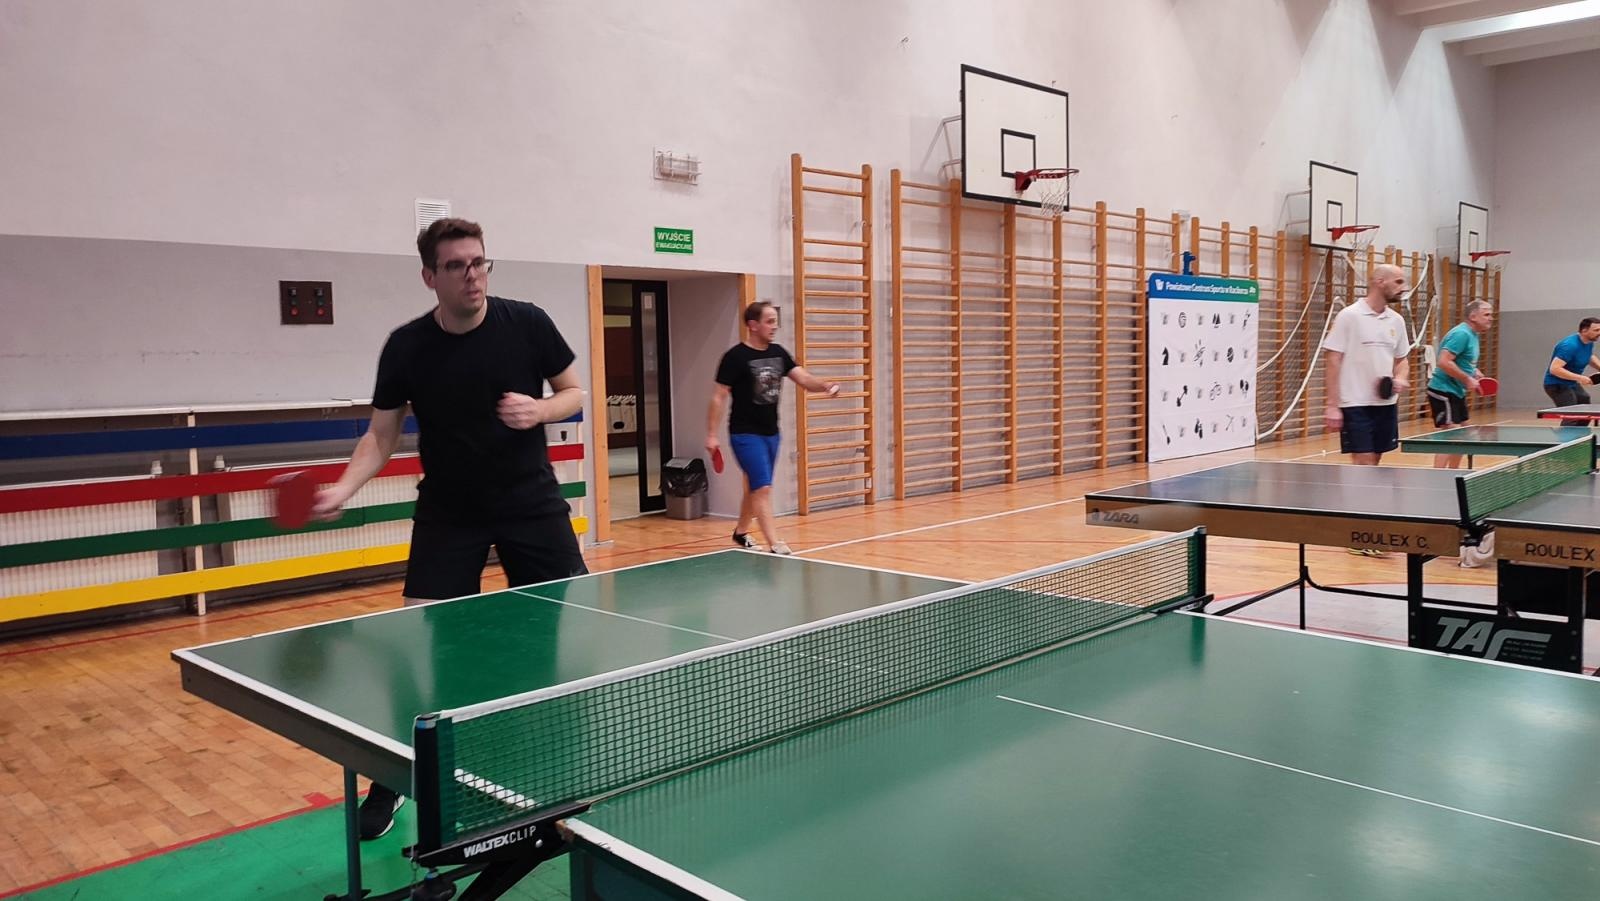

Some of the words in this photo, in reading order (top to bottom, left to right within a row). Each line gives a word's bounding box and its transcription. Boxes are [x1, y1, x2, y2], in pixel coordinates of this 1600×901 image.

[657, 231, 691, 242] WYJŚCIE
[1351, 531, 1410, 546] ROULEX
[1525, 543, 1596, 562] ROULEX
